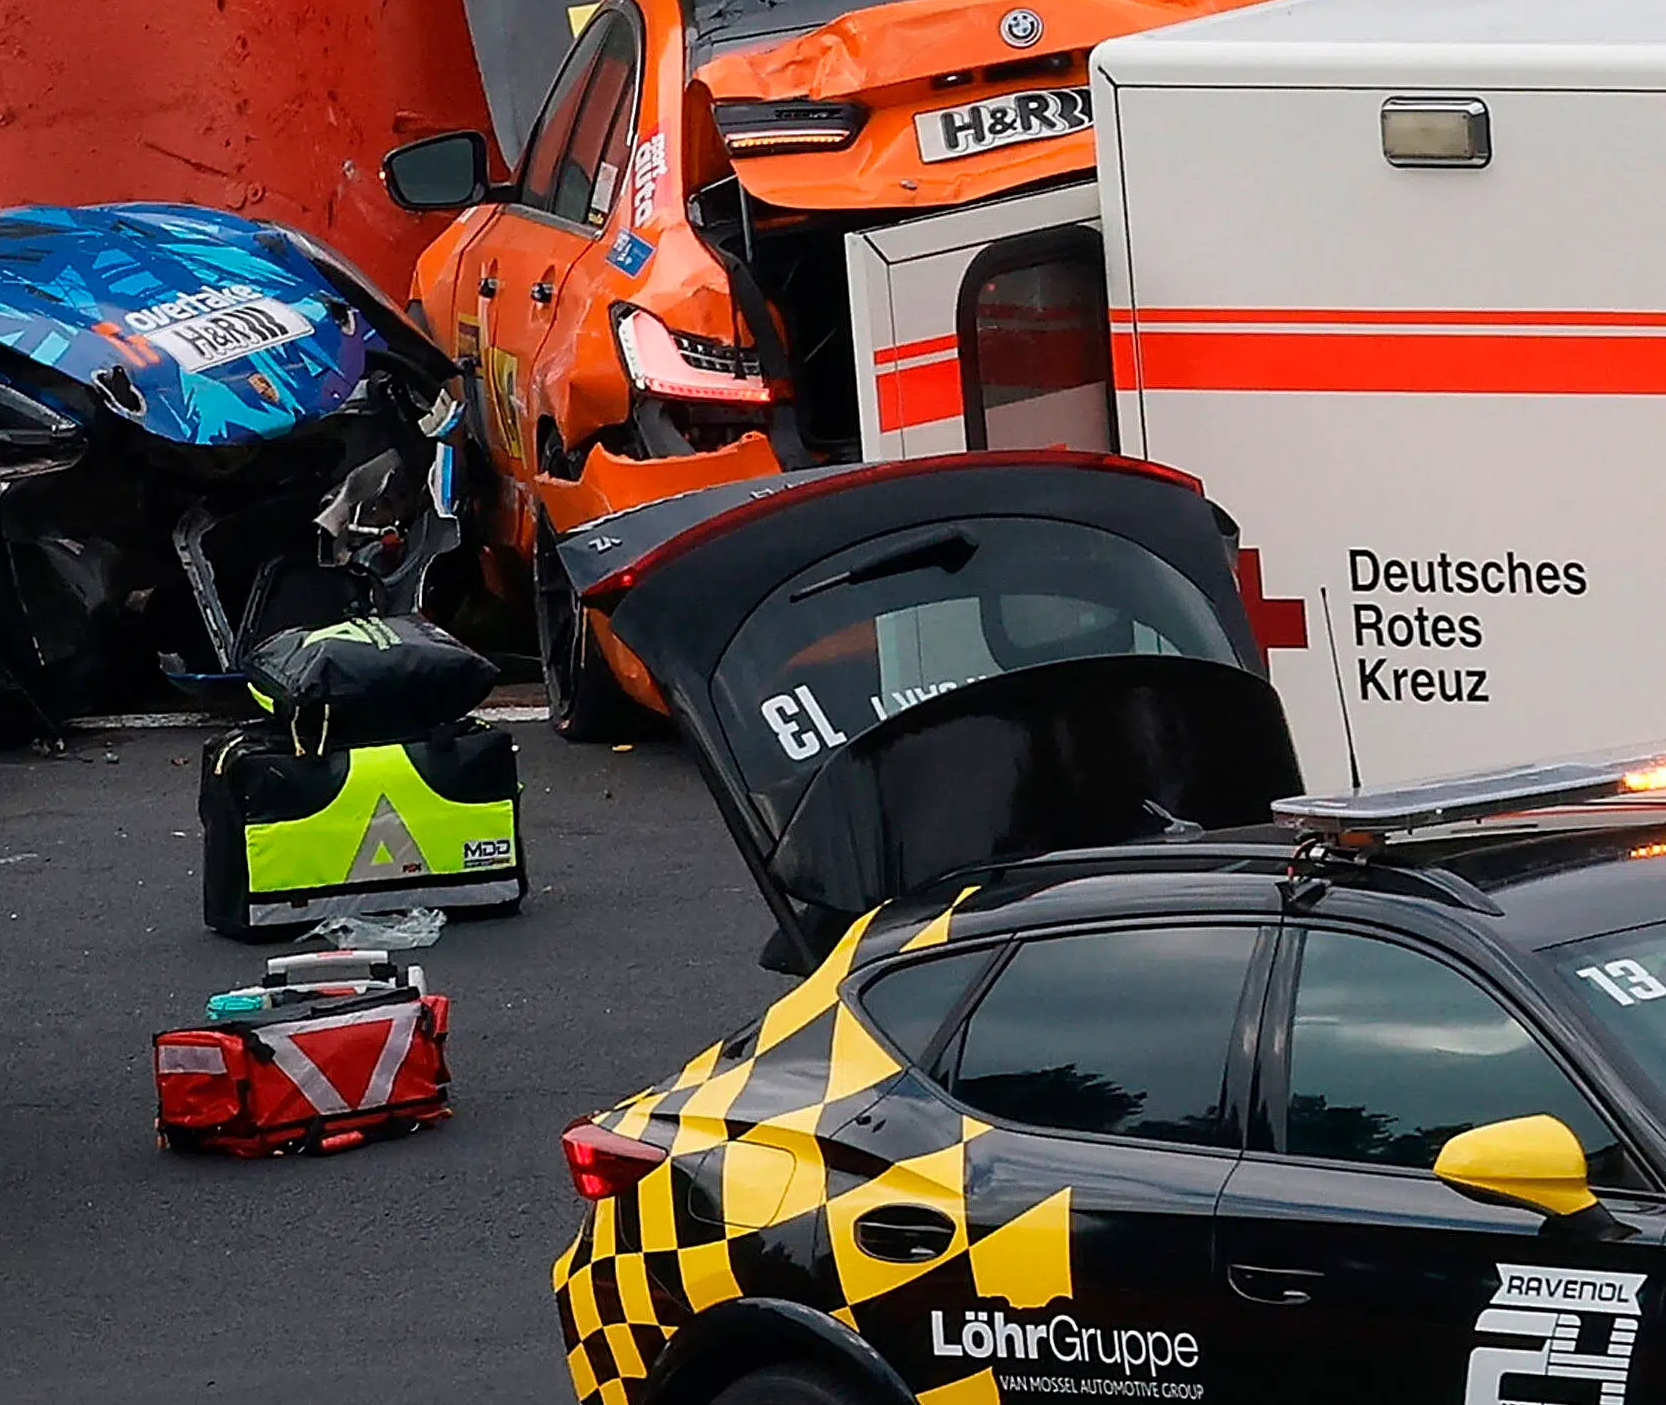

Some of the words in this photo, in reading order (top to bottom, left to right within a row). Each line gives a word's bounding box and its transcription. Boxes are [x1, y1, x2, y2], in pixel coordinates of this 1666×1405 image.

[124, 283, 263, 331] overtake
[1347, 548, 1587, 596] Deutsches
[1353, 603, 1483, 651] Rotes
[1358, 657, 1491, 704] Kreuz
[1506, 1275, 1630, 1303] RAVENOL
[931, 1310, 1200, 1377] LöhrGruppe
[999, 1375, 1028, 1392] VAN
[1030, 1377, 1077, 1394] MOSSEL
[1080, 1379, 1160, 1398] AUTOMOTIVE
[1161, 1382, 1205, 1400] GROUP
